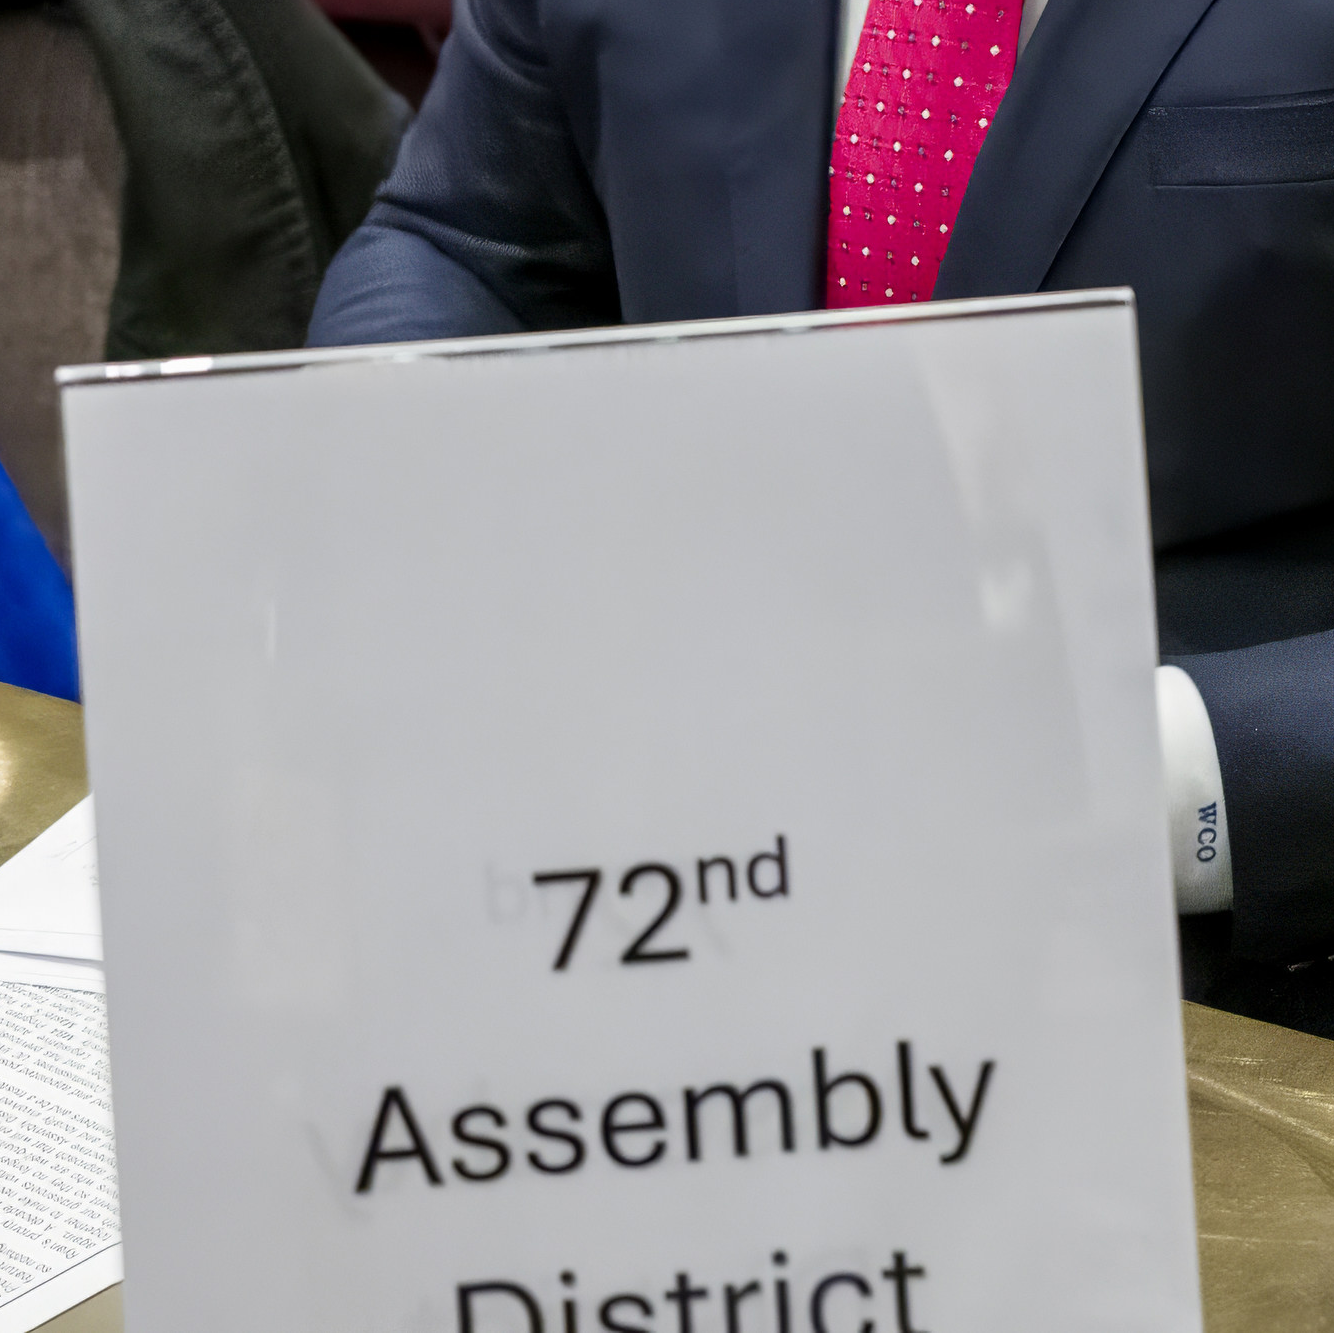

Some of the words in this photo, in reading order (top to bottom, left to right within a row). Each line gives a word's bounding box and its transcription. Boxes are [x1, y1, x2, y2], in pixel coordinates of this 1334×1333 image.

[1196, 801, 1217, 863] WCO
[533, 834, 792, 971] 72nd
[353, 1040, 997, 1194] Assembly
[456, 1251, 928, 1333] District
